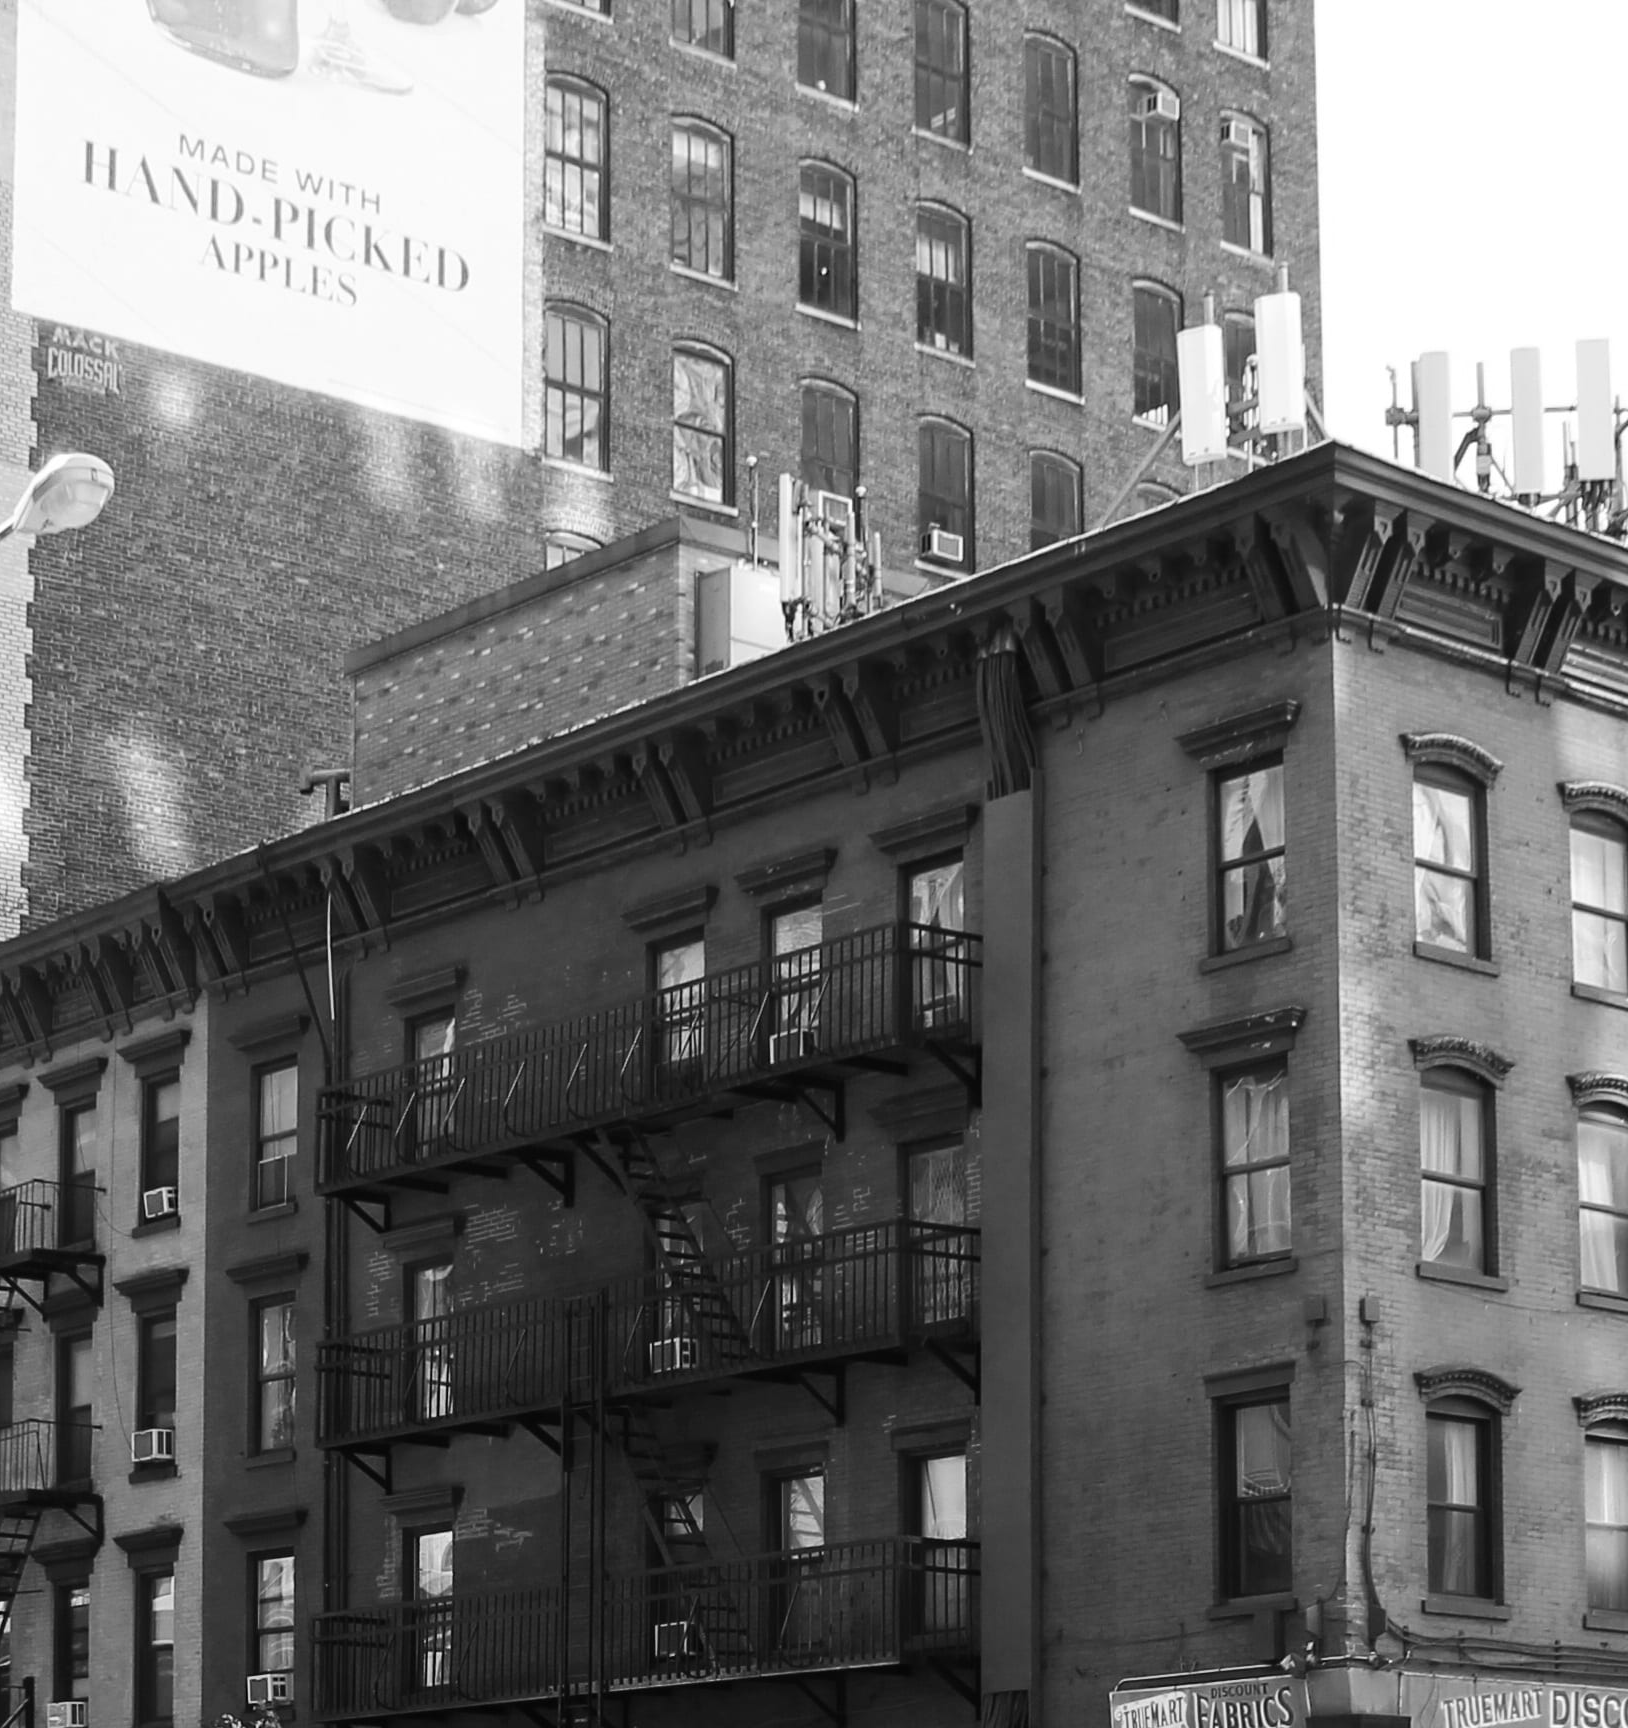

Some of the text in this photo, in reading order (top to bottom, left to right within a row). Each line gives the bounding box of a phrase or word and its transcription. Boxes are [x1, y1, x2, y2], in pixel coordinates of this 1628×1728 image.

[178, 133, 382, 215] MADE WITH
[80, 139, 471, 294] HAND-PICKED
[199, 233, 359, 307] APPLES
[47, 346, 123, 395] COLOSSAL
[1210, 1681, 1270, 1700] DISCOUNT
